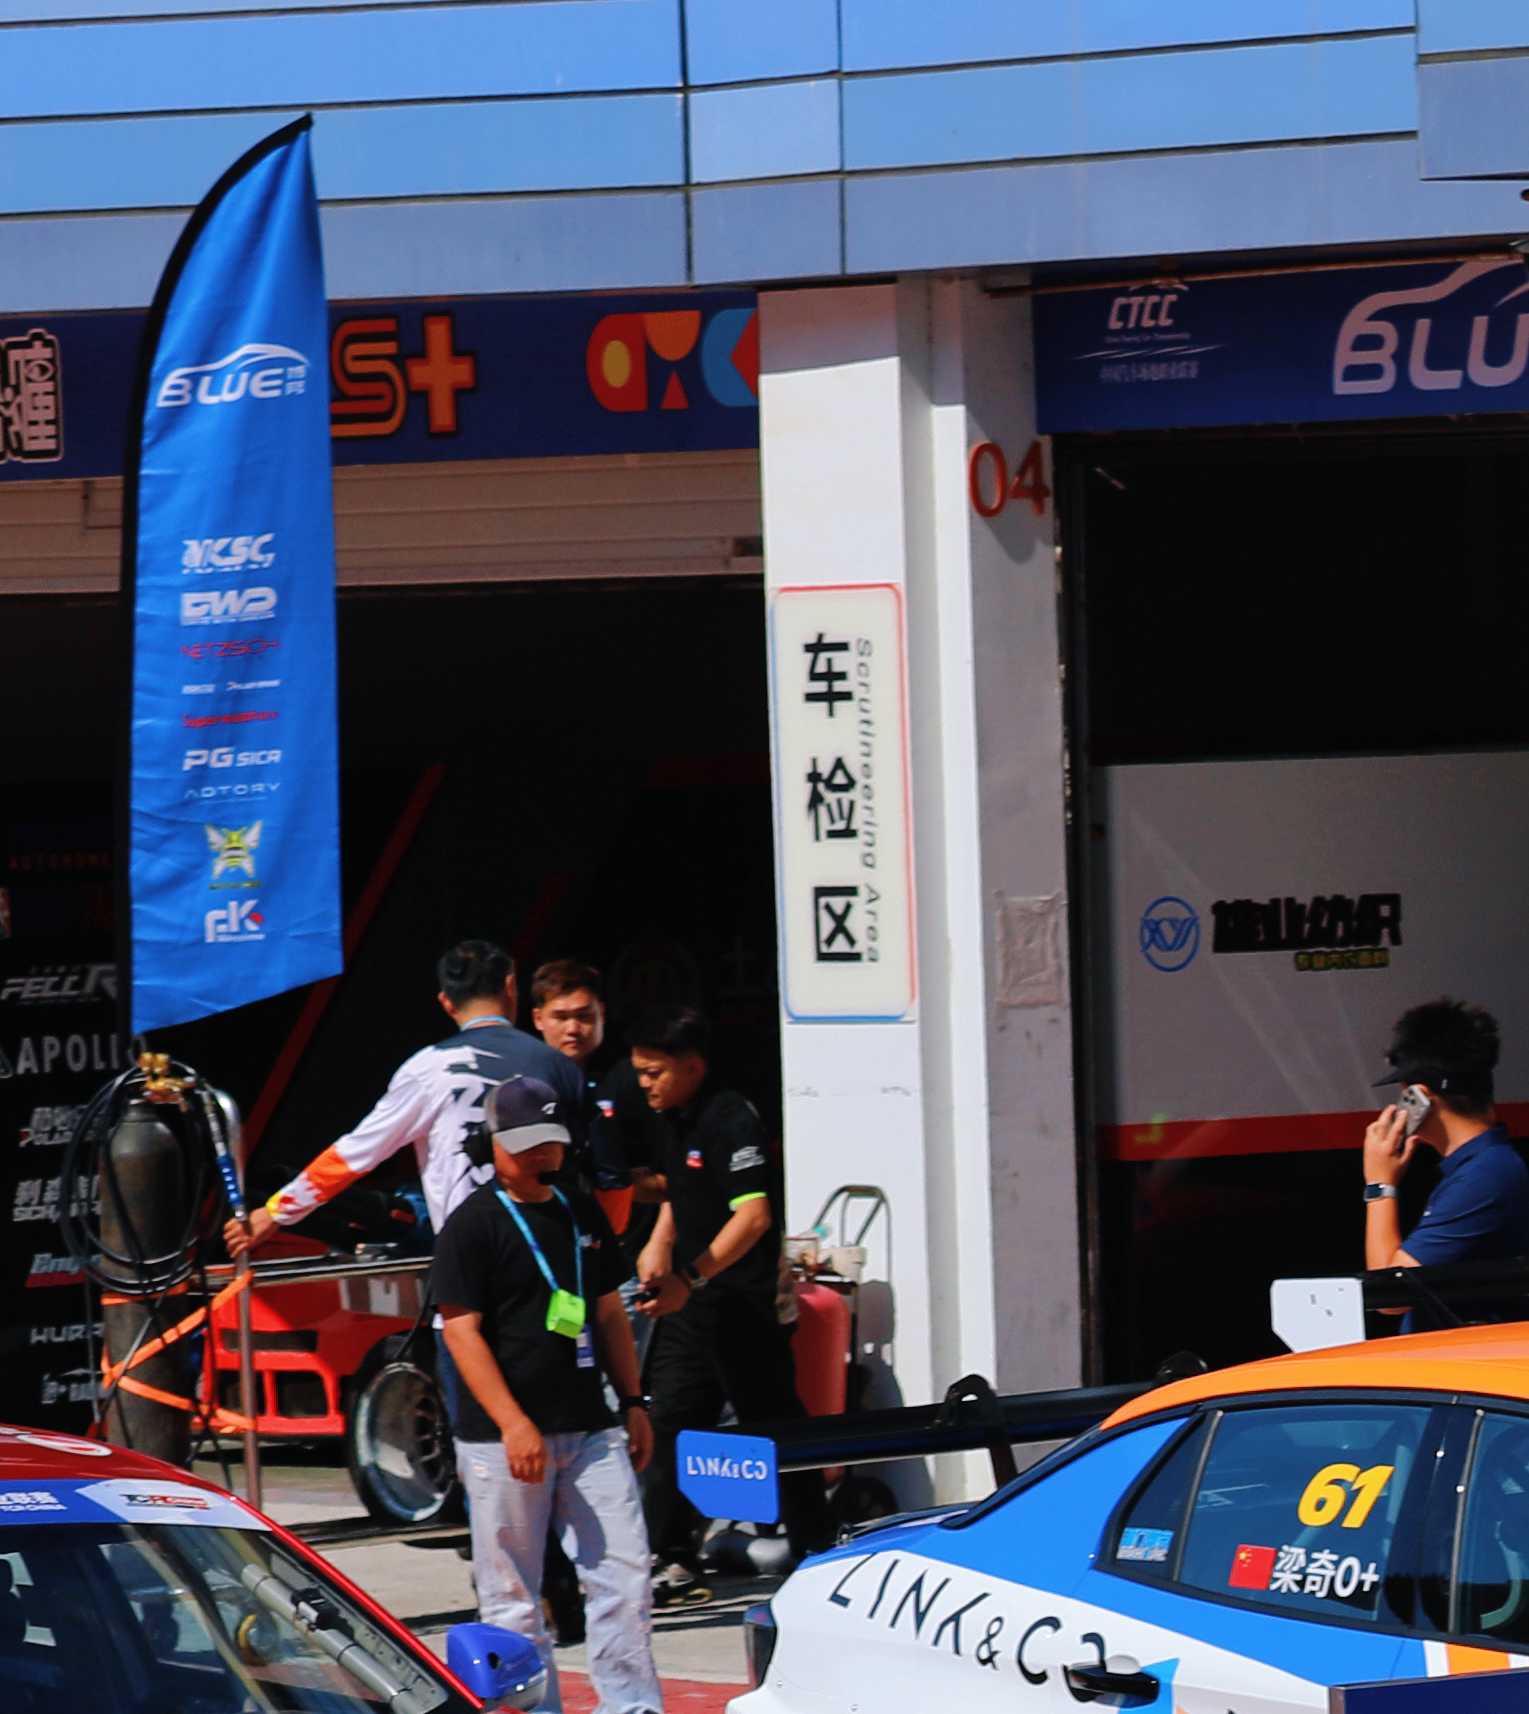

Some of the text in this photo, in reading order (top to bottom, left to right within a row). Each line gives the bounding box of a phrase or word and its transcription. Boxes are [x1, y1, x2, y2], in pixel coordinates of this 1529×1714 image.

[1107, 293, 1179, 331] CTCC
[156, 366, 285, 408] BLUE
[968, 440, 1053, 518] 04
[802, 633, 863, 964] 车检区
[855, 636, 881, 964] Scrutineering Area
[1297, 1463, 1395, 1529] 61
